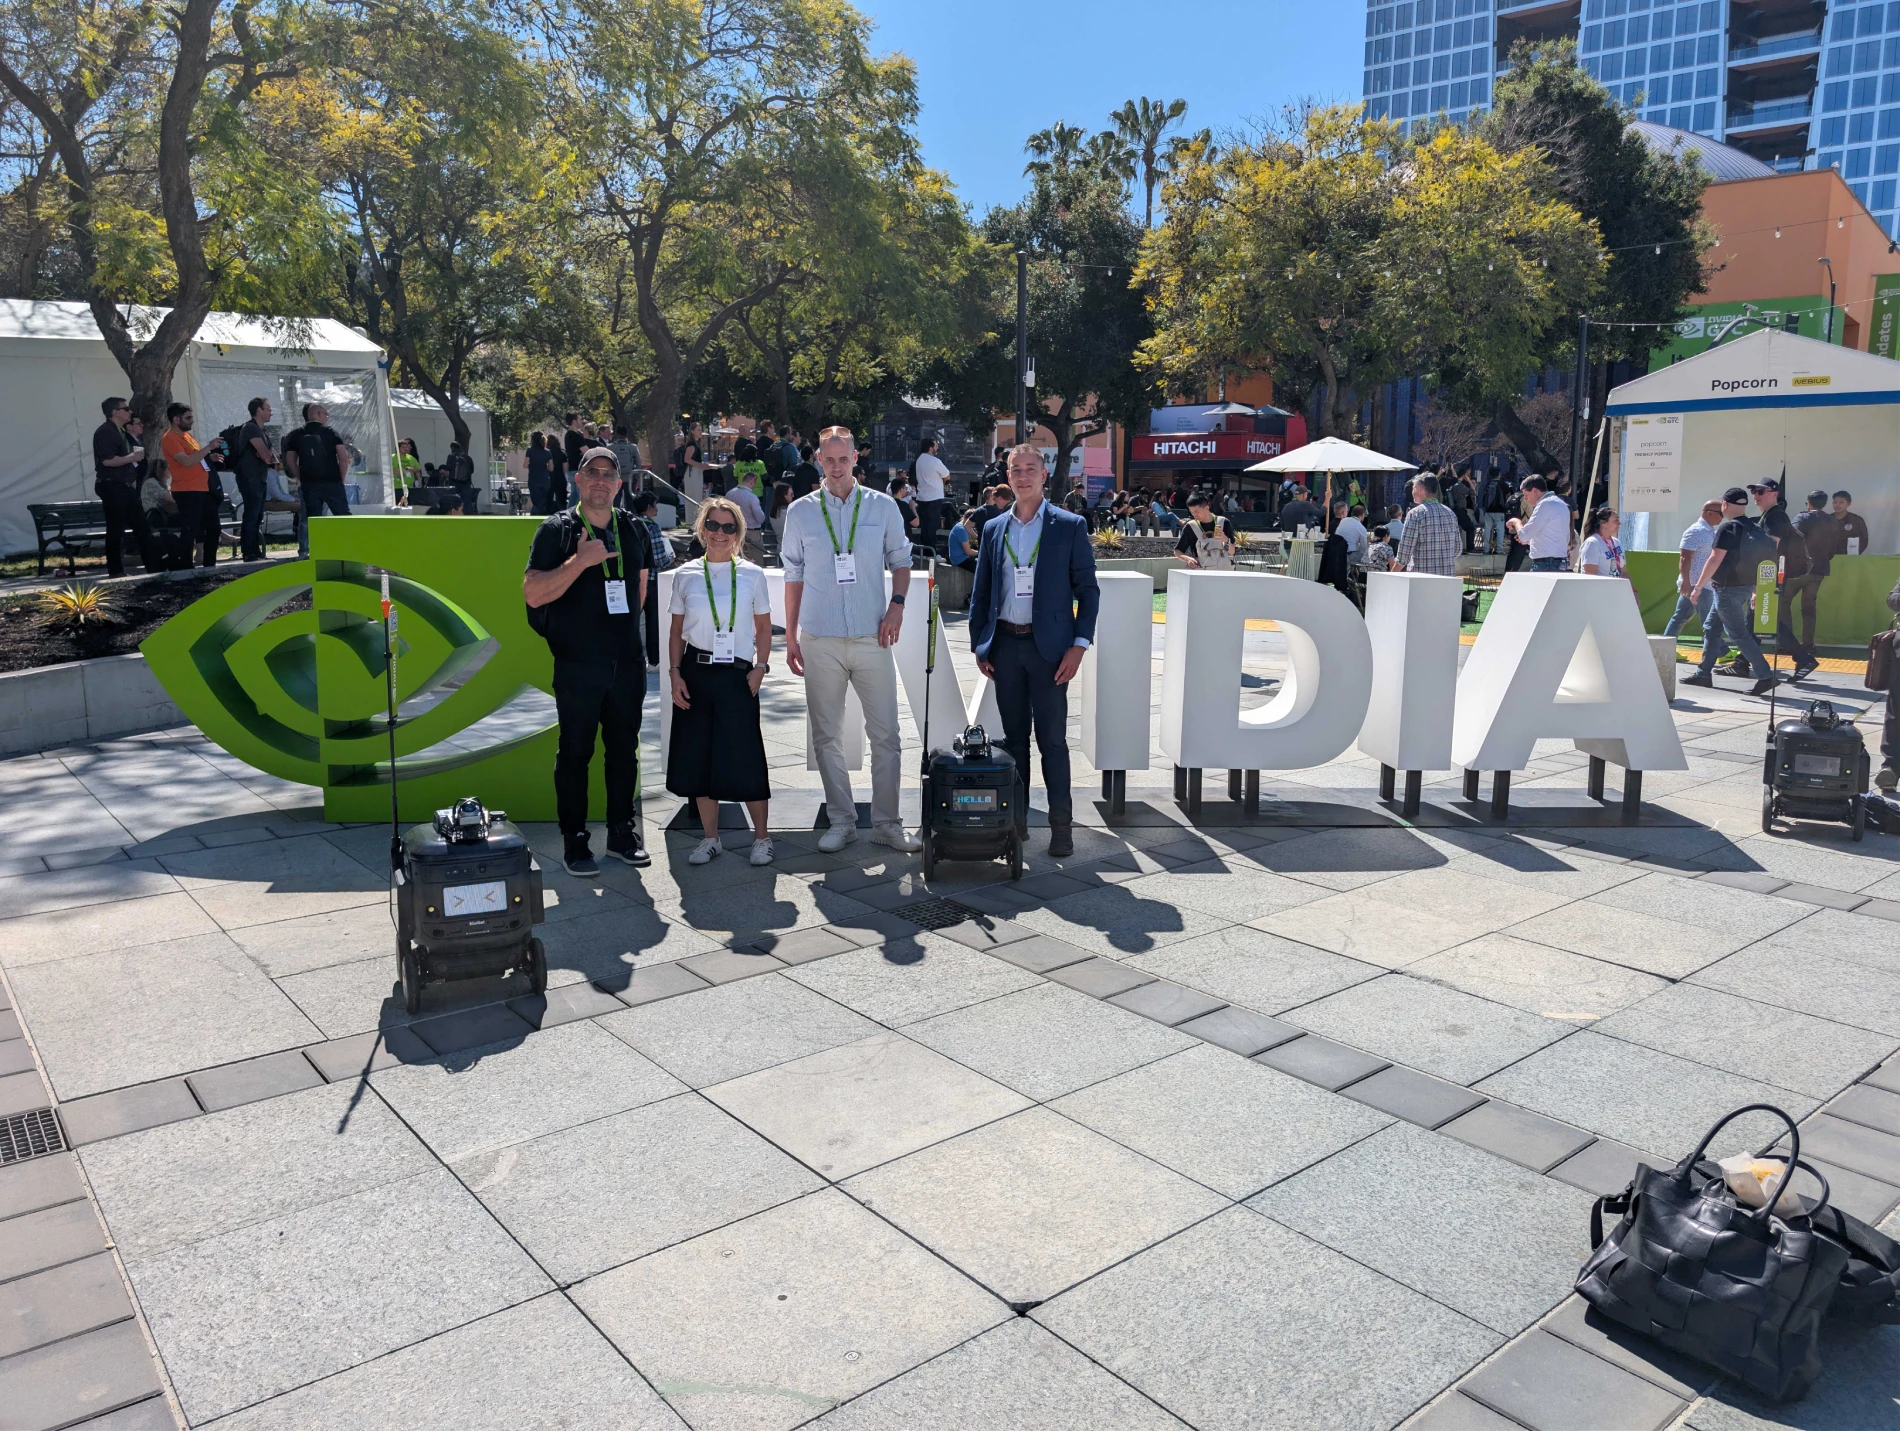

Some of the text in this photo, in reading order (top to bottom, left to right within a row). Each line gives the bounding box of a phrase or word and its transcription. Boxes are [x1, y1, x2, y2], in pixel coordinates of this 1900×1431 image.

[1711, 378, 1778, 392] Popcorn
[1153, 440, 1217, 455] HITACHI
[1246, 440, 1281, 455] HITACHI
